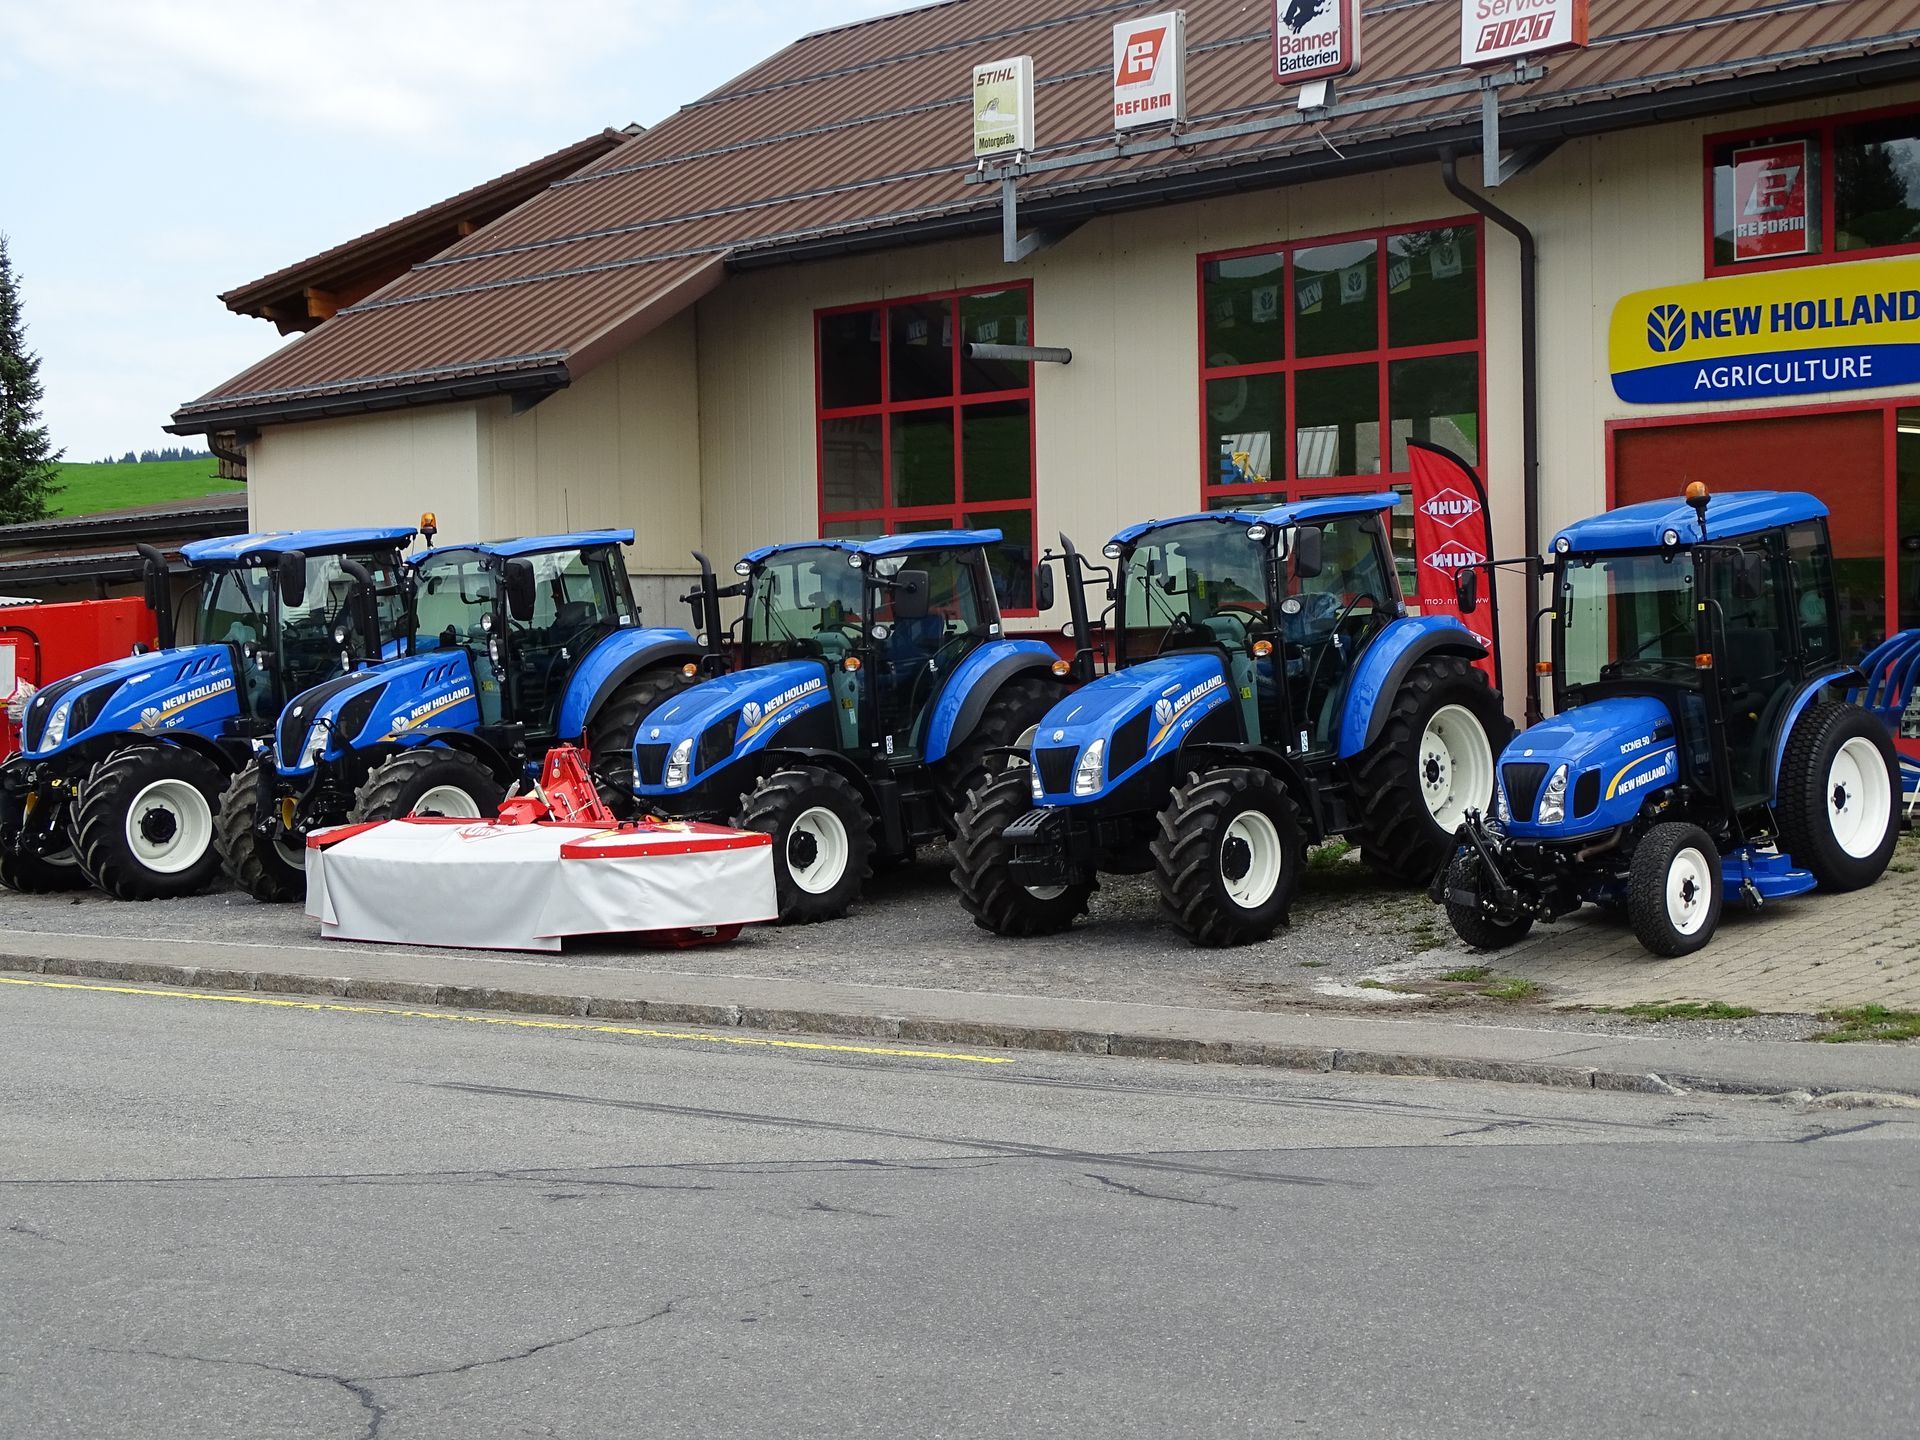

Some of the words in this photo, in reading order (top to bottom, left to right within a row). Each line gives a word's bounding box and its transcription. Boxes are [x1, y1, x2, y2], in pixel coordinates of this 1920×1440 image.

[1476, 0, 1556, 19] Servi
[1280, 30, 1338, 56] Banner
[1477, 12, 1556, 51] FIAT
[1280, 49, 1338, 72] Batterien
[976, 67, 1015, 87] STIHL
[1116, 93, 1171, 116] REFORM
[979, 133, 1015, 149] Motorgeräte
[1738, 216, 1804, 237] REFORM
[1691, 304, 1763, 340] NEW
[1770, 289, 1920, 333] HOLLAND
[1694, 355, 1872, 390] AGRICULTURE
[162, 693, 187, 711] NEW
[187, 678, 232, 701] HOLLAND
[411, 702, 432, 719] NEW
[432, 686, 470, 710] HOLLAND
[764, 693, 785, 714] NEW
[784, 677, 821, 702] HOLLAND
[1173, 691, 1192, 713] NEW
[1191, 674, 1222, 700] HOLLAND
[1620, 738, 1642, 755] BOOMER
[1642, 735, 1650, 746] 50
[1618, 778, 1636, 796] NEW
[1635, 765, 1666, 788] HOLLAND
